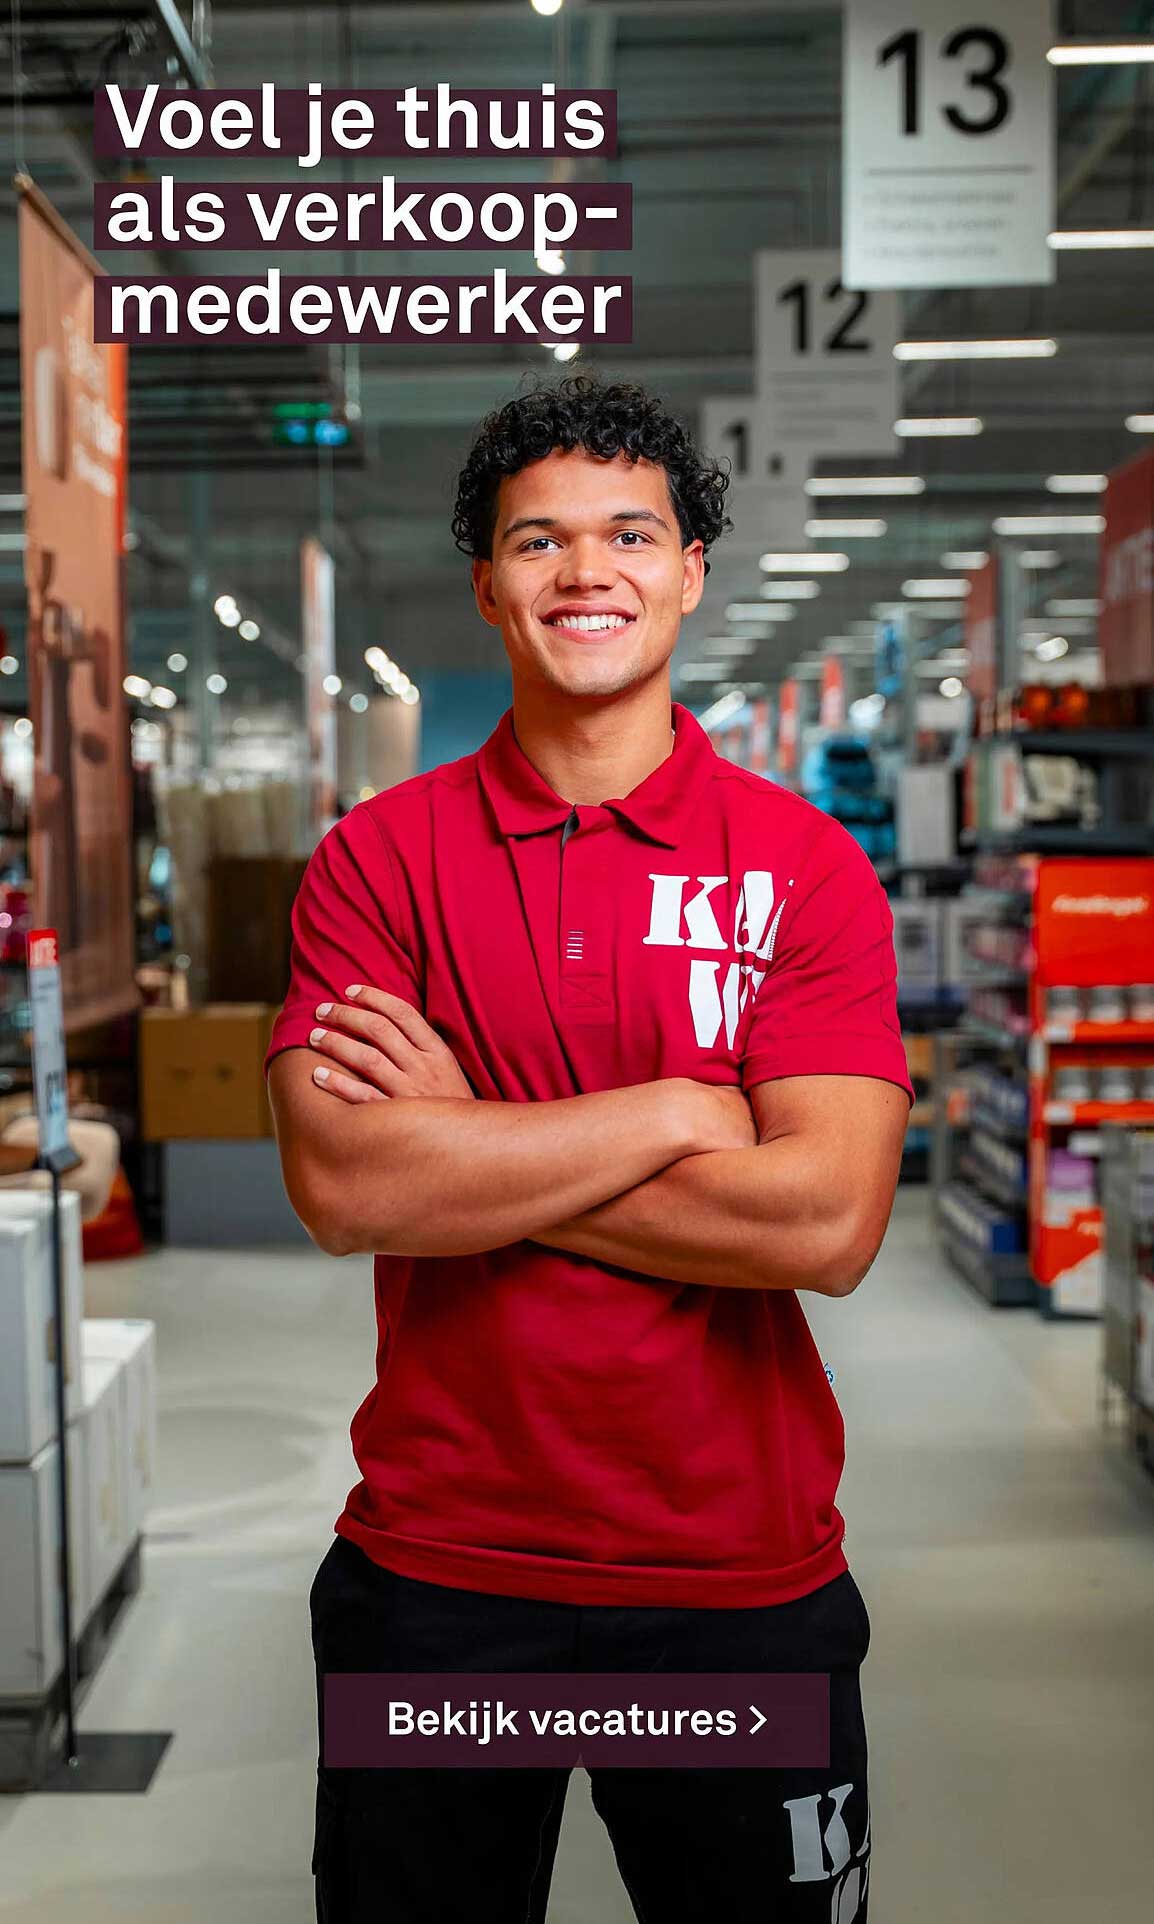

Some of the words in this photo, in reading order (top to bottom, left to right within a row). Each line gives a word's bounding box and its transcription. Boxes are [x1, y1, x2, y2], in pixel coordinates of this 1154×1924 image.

[877, 25, 1013, 136] 13
[775, 281, 872, 357] 12
[721, 417, 785, 478] 1
